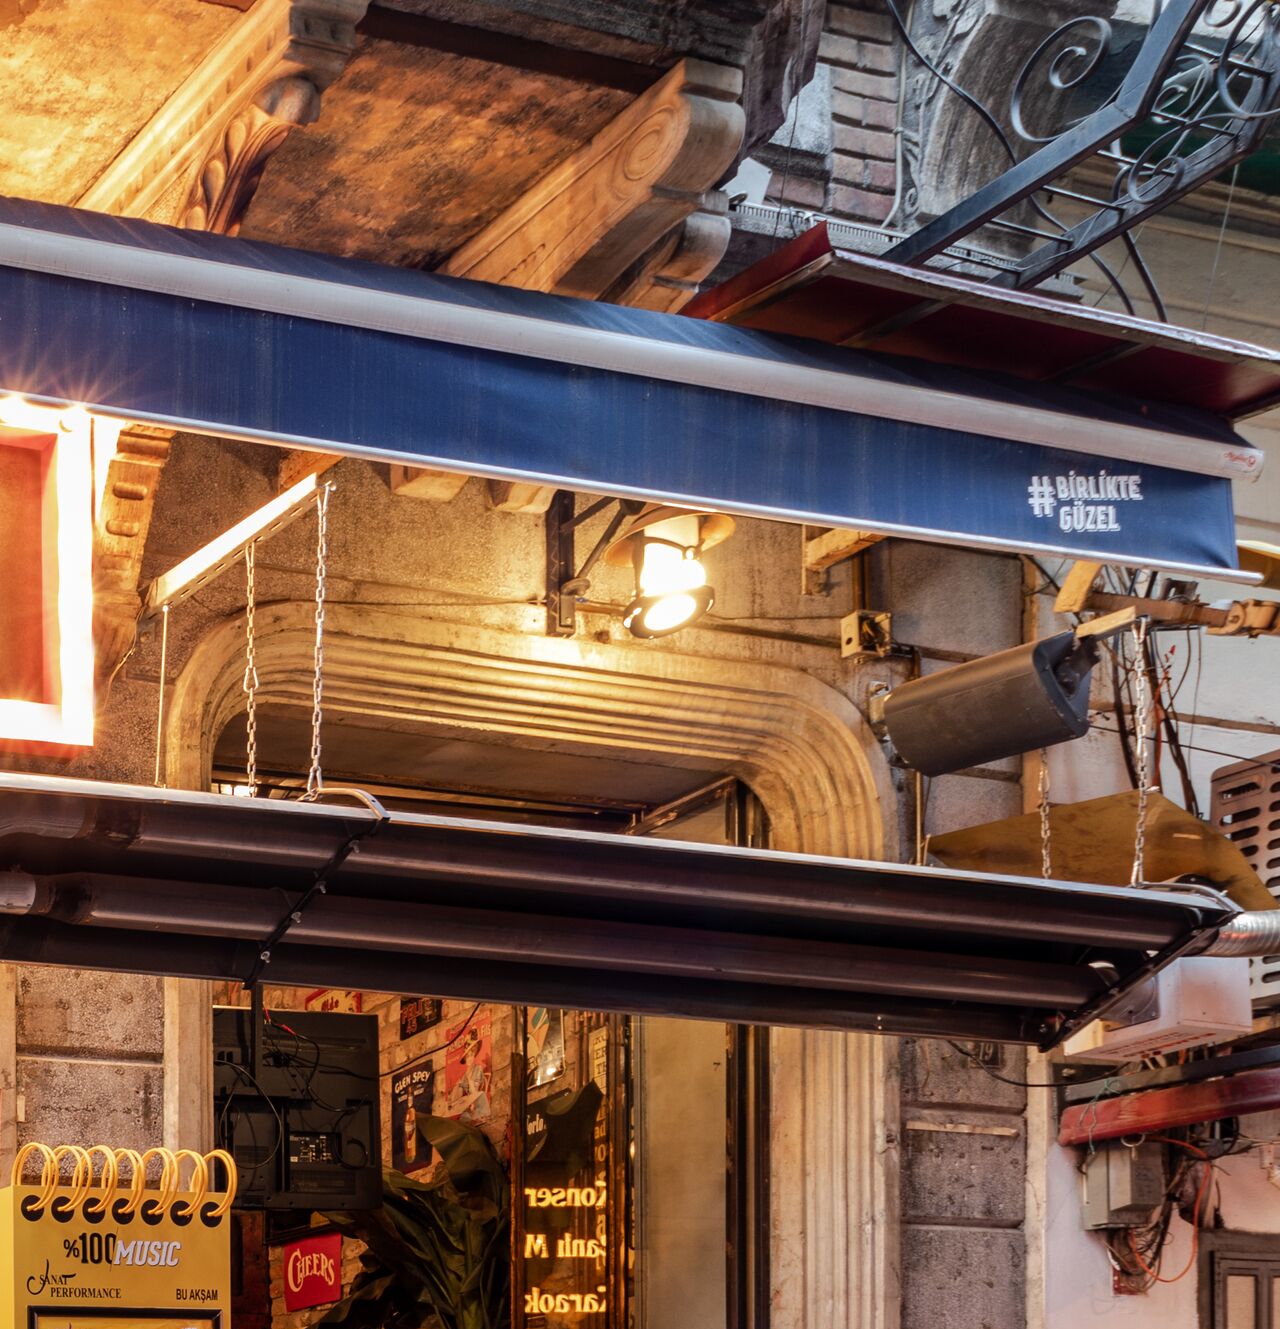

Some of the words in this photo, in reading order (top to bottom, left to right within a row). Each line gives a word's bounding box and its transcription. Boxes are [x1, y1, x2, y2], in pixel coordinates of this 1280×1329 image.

[1059, 501, 1121, 532] GÜZEL
[394, 1074, 411, 1094] GLEN
[412, 1070, 431, 1084] SPEY
[113, 1239, 182, 1267] MUSIC
[26, 1259, 77, 1295] SANAT
[287, 1248, 335, 1292] CHEERS
[50, 1287, 122, 1299] PERFORMANCE
[175, 1289, 188, 1301] BU
[189, 1289, 219, 1304] AKŞAM
